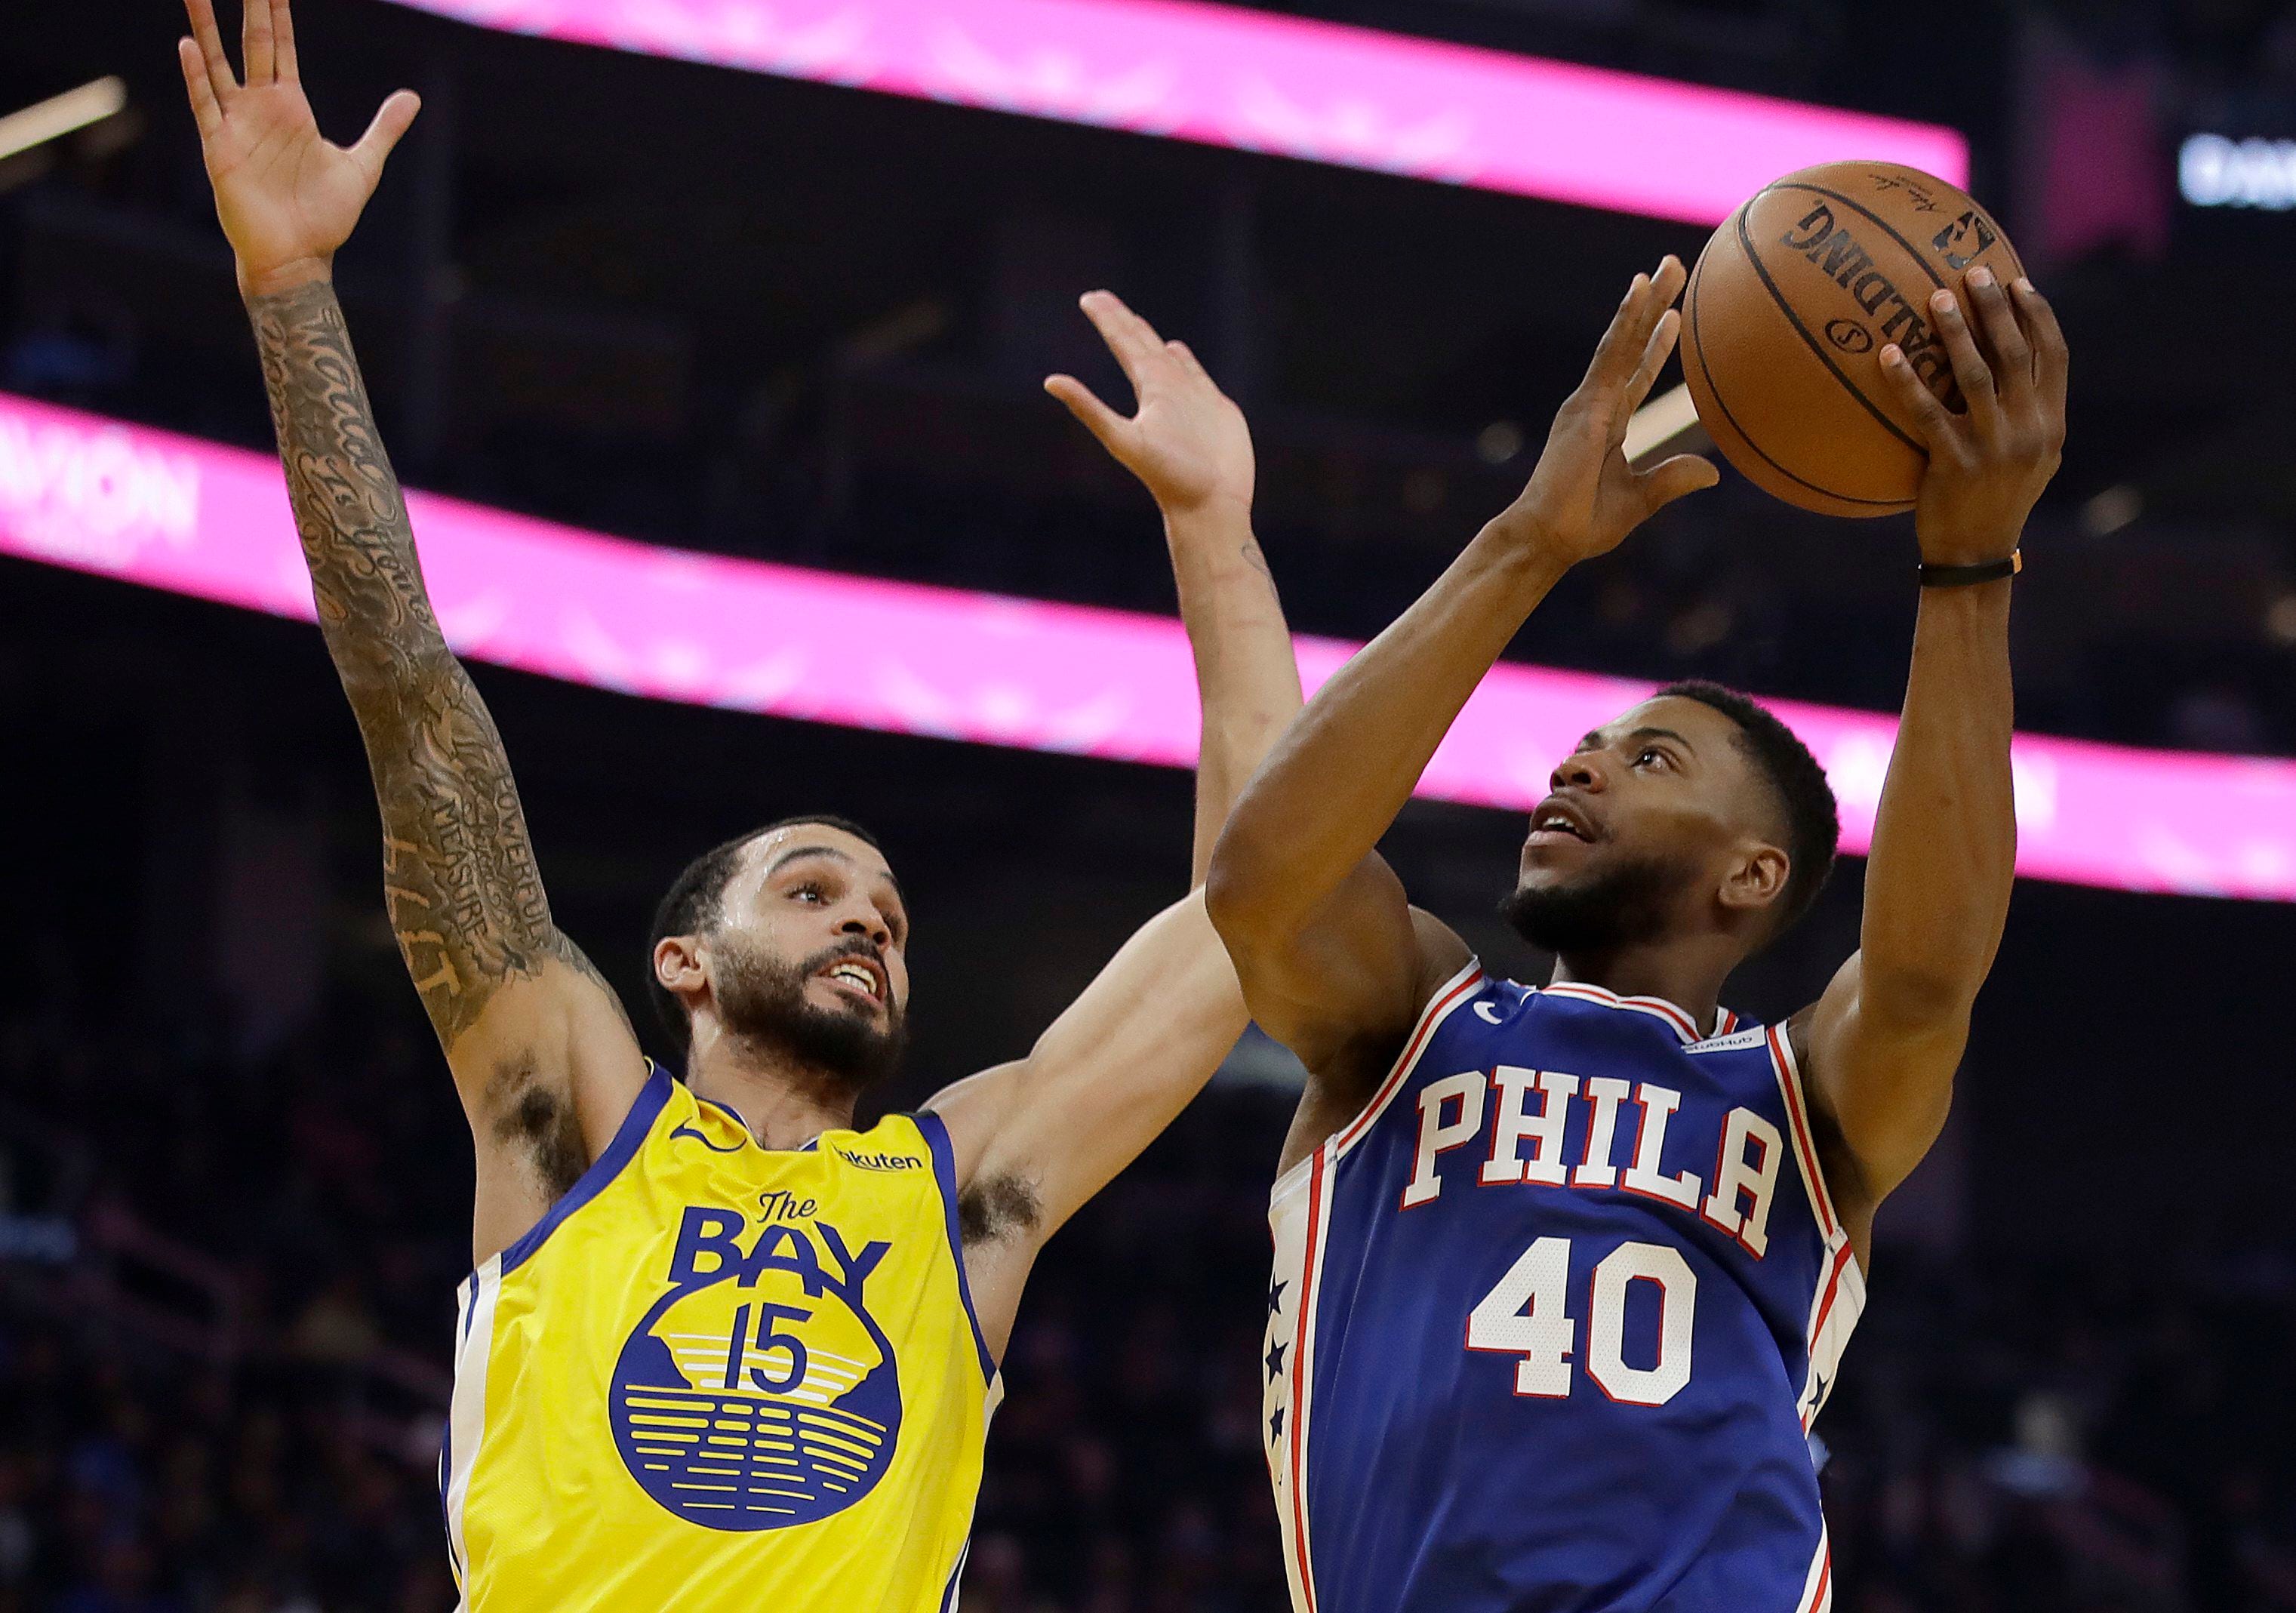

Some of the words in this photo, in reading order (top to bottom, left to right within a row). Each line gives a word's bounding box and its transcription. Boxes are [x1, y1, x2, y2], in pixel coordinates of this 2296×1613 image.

[1779, 202, 1965, 412] PALDING
[432, 800, 489, 943] MEASURE
[494, 774, 549, 943] POWERFUL
[757, 1190, 818, 1224] The
[1399, 1065, 1784, 1261] PHILA
[667, 1205, 892, 1307] BAY
[1466, 1236, 1697, 1407] 40
[724, 1302, 813, 1395] 15
